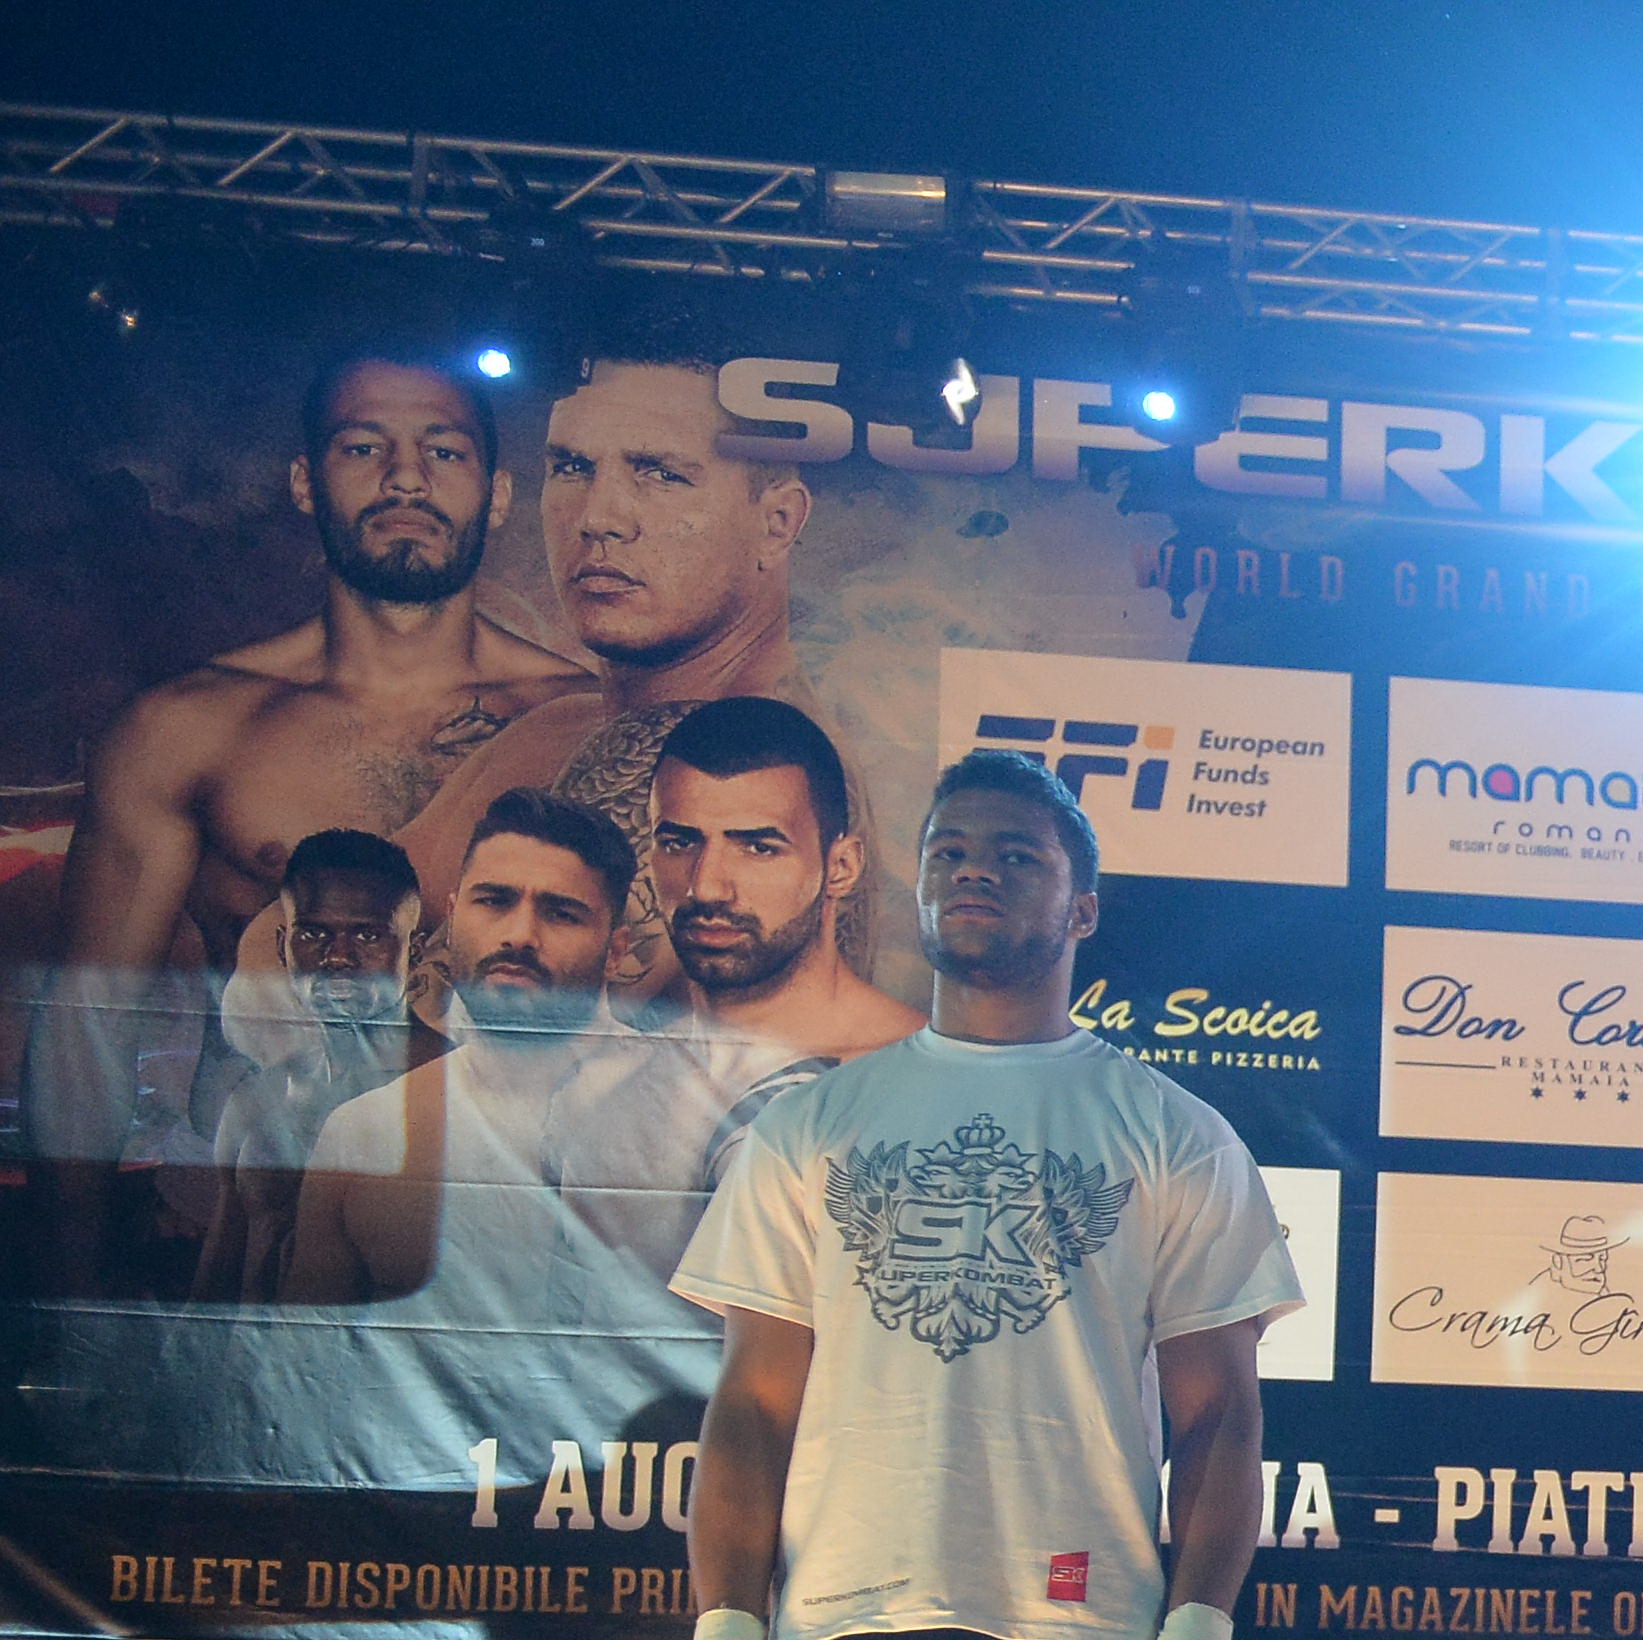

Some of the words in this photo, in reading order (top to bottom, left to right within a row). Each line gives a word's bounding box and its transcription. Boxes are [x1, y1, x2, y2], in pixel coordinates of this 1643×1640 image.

[1133, 543, 1346, 603] WORLD
[1395, 561, 1592, 619] GRAND
[1199, 729, 1325, 758] European
[1193, 761, 1270, 786] Funds
[1187, 794, 1267, 818] Invest
[1449, 840, 1493, 855] RESORT
[1497, 841, 1512, 855] OF
[1068, 978, 1136, 1031] La
[1155, 987, 1322, 1041] Scoica
[1393, 974, 1525, 1042] Don
[1211, 1051, 1322, 1071] PIZZERIA
[1530, 1071, 1631, 1088] MAMAIA
[1389, 1286, 1562, 1351] Crama
[469, 1438, 499, 1528] 1
[111, 1555, 283, 1609] BILETE
[306, 1559, 590, 1617] DISPONIBILE
[1255, 1582, 1297, 1628] IN
[1318, 1584, 1592, 1637] MAGAZINELE
